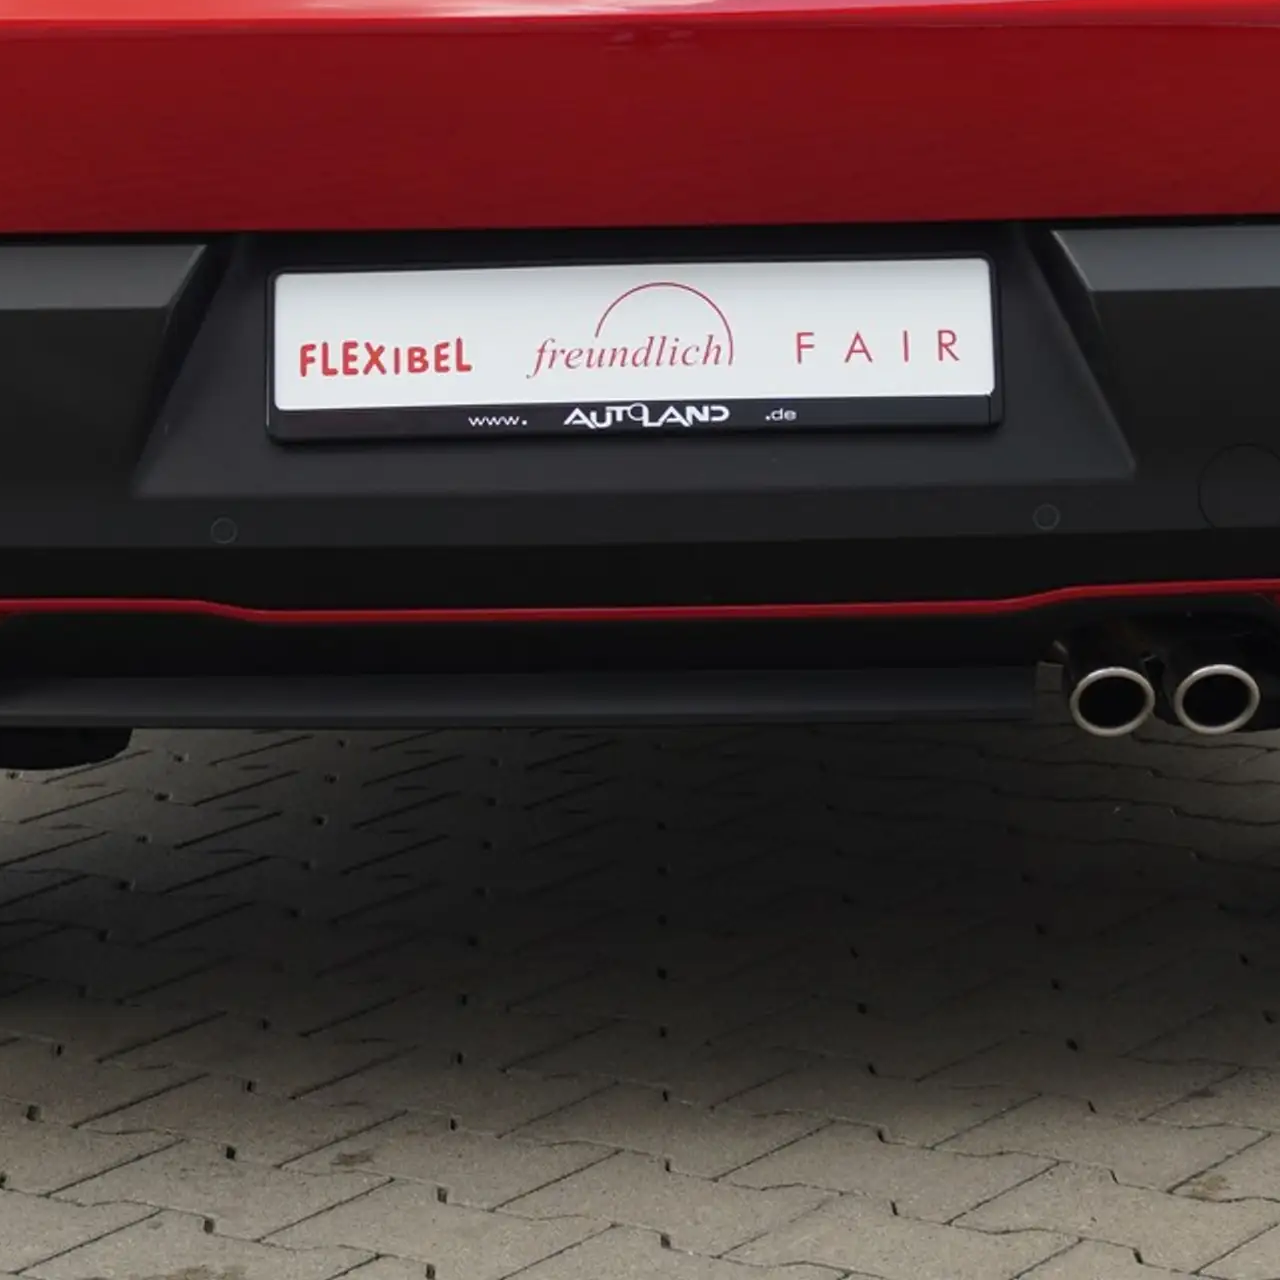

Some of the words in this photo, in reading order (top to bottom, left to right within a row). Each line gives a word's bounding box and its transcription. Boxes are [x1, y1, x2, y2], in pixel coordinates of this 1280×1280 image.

[299, 338, 472, 378] FLEXIBEL
[526, 334, 723, 379] freundlich
[796, 330, 960, 363] FAIR
[468, 415, 528, 427] www.
[563, 402, 730, 429] AUTOLAND
[765, 408, 797, 422] .de
